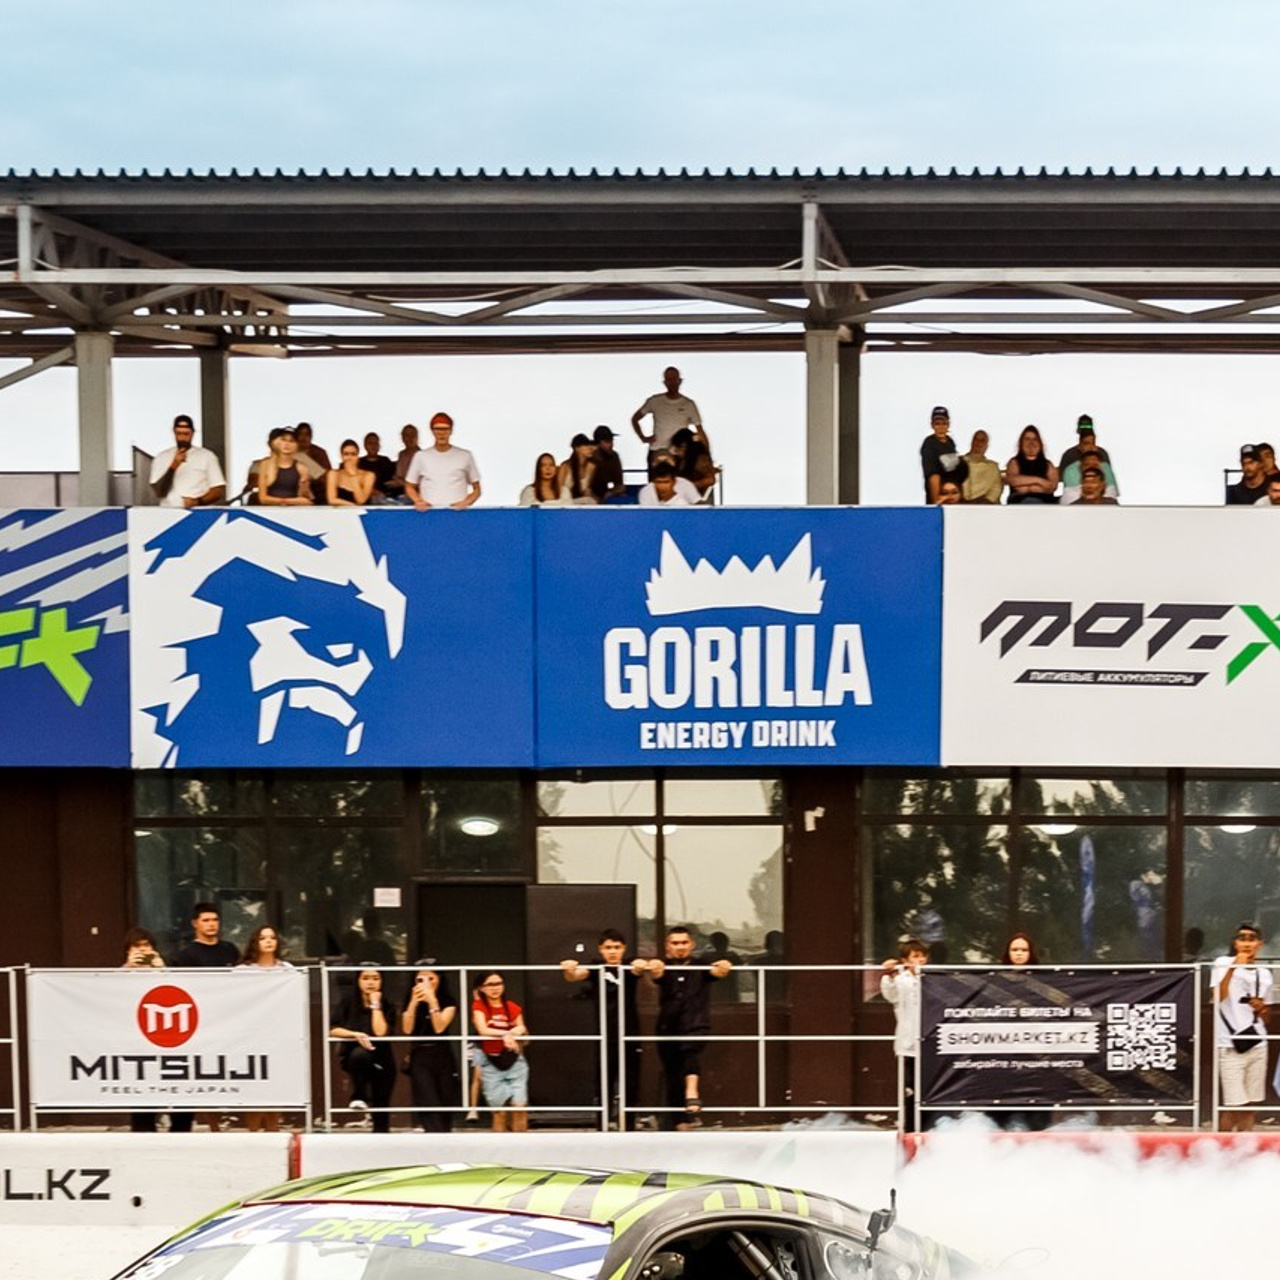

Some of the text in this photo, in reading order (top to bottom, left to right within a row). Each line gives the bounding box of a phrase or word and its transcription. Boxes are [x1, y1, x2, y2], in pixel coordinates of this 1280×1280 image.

[603, 623, 873, 710] GORILLA
[640, 719, 837, 750] ENERGY DRINK
[948, 1032, 1089, 1045] SHOWMARKET.KZ
[69, 1055, 269, 1080] MITSUJI
[101, 1086, 240, 1094] FEEL THE JAPAN
[4, 1168, 111, 1201] L.KZ
[297, 1217, 443, 1247] DRIFT
